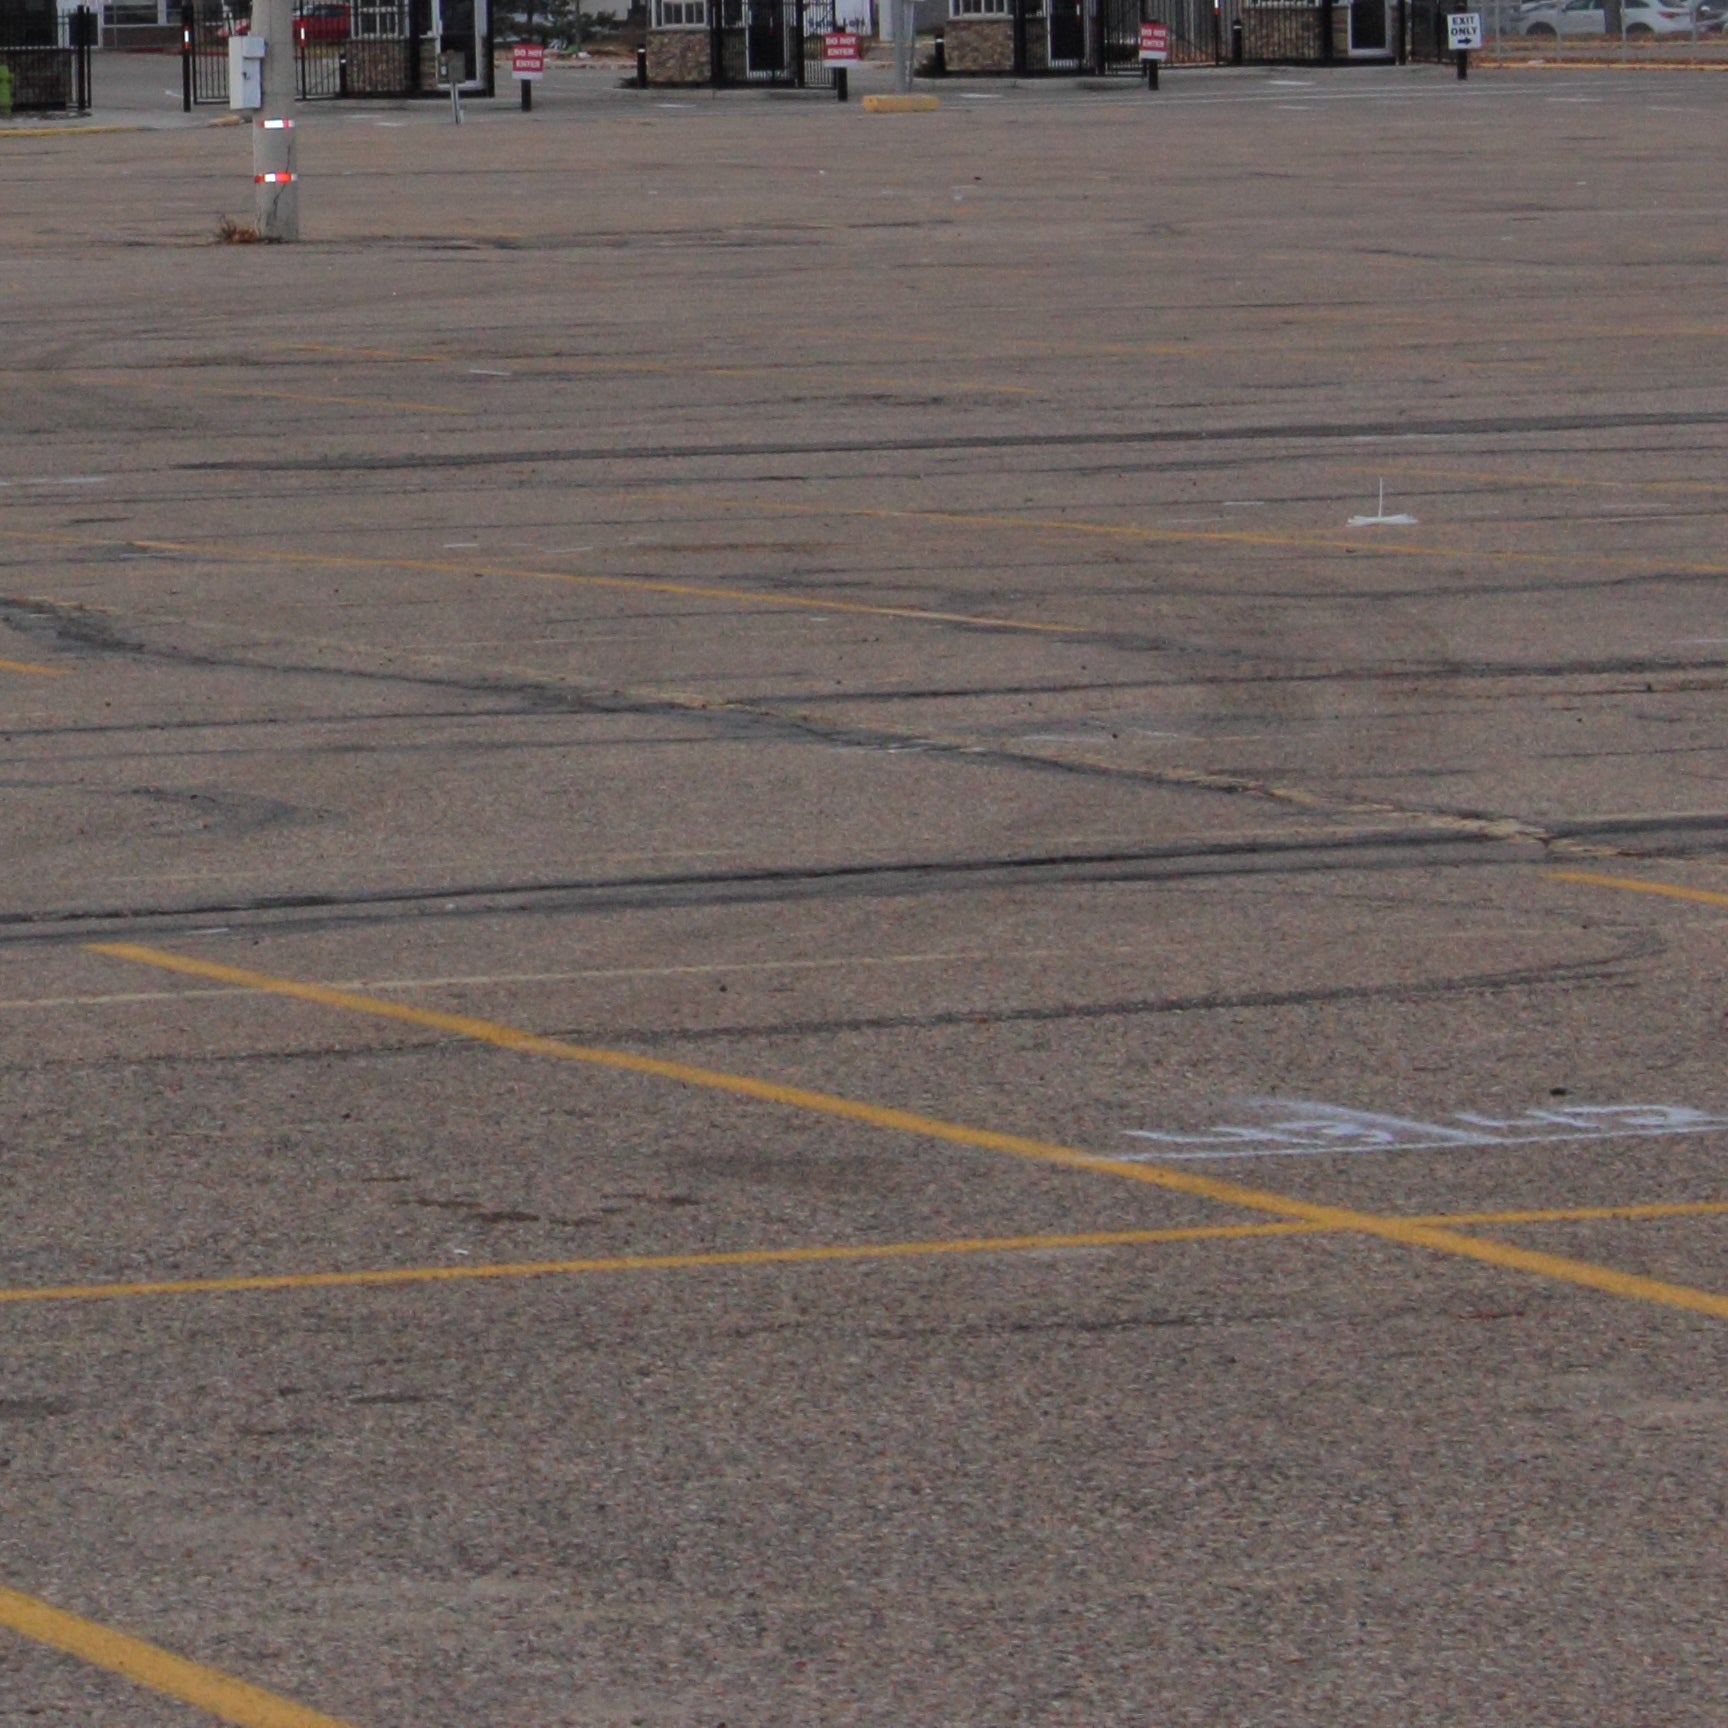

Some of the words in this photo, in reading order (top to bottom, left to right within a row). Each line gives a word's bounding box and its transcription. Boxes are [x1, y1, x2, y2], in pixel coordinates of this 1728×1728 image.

[1452, 16, 1475, 26] EXIT
[1451, 26, 1478, 37] ONLY
[827, 47, 855, 57] ENTER
